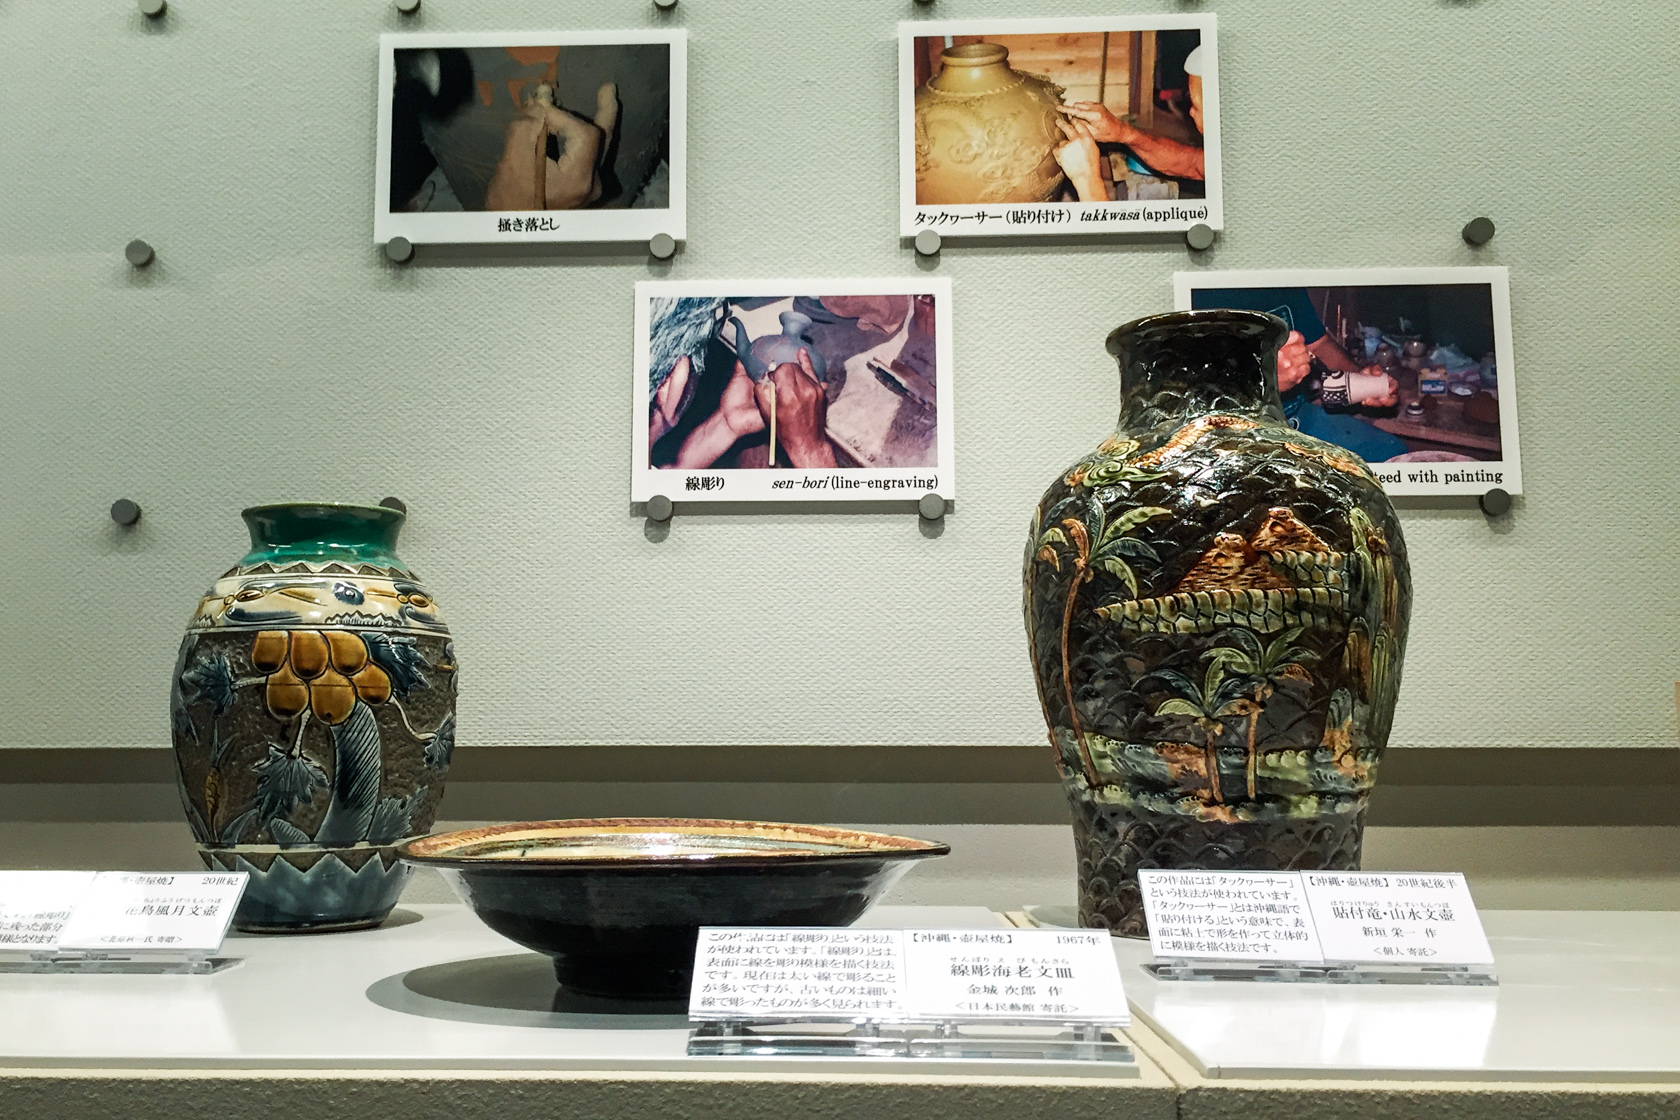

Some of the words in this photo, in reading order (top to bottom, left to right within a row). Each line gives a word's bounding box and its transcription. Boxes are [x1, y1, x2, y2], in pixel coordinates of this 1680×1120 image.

[498, 217, 560, 232] 掻き落とし
[685, 476, 725, 490] 線彫り
[772, 475, 829, 489] sen-bori
[831, 475, 939, 490] (line-engraving)
[1408, 470, 1438, 483] with
[1444, 469, 1504, 484] painting
[201, 876, 239, 886] 20世紀
[1395, 878, 1457, 889] 20世紀後半
[1150, 888, 1298, 902] という技法が使われています。
[1055, 935, 1101, 946] 1967年
[1160, 940, 1278, 954] に模様を描く技法です。
[950, 964, 1076, 979] 線彫海老文皿
